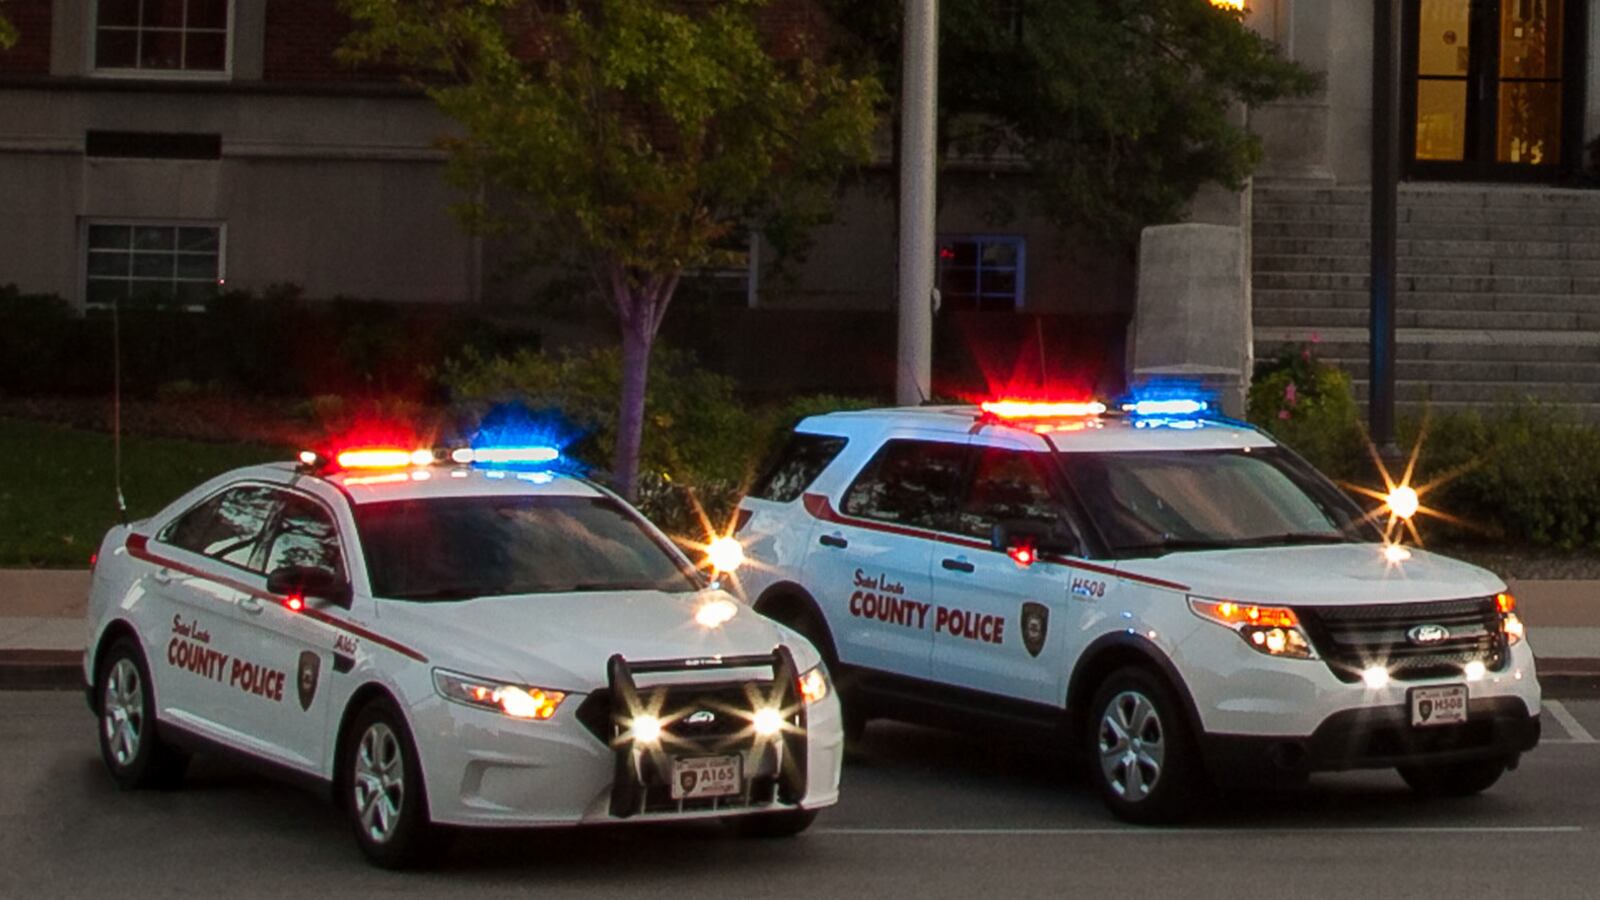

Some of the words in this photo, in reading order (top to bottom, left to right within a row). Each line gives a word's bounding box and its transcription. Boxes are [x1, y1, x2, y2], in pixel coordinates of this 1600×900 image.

[850, 591, 931, 629] COUNTY
[935, 607, 1005, 644] POLICE
[168, 637, 229, 682] COUNTY
[230, 658, 286, 701] POLICE
[1434, 697, 1463, 711] H508
[700, 768, 735, 782] A165
